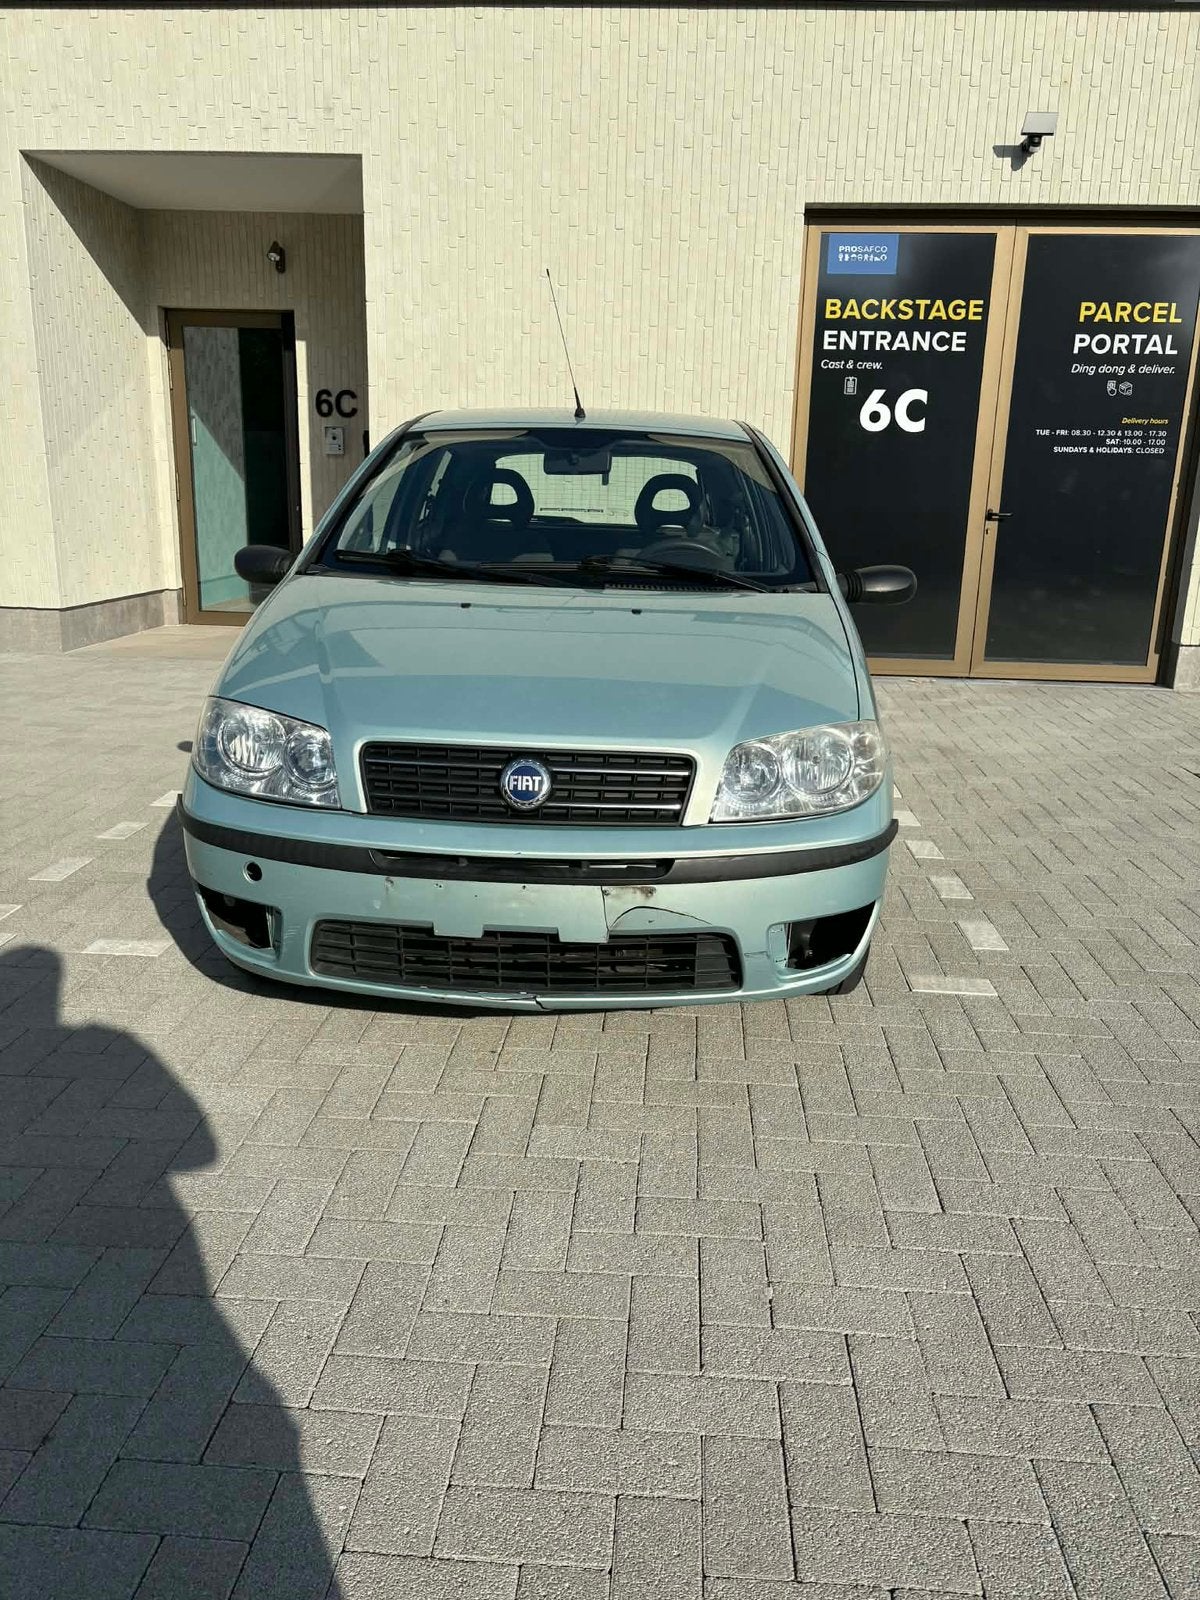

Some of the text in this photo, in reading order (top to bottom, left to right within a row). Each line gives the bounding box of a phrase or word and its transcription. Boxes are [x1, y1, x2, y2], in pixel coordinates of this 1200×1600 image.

[825, 298, 984, 321] BACKSTAGE
[1079, 301, 1182, 323] PARCEL
[823, 330, 967, 352] ENTRANCE
[1073, 334, 1178, 355] PORTAL
[820, 359, 883, 370] Cast & crew.
[1071, 364, 1176, 376] Ding dong & deliver.
[316, 388, 358, 418] 6C
[859, 388, 928, 433] 6C
[510, 775, 542, 791] FIAT
